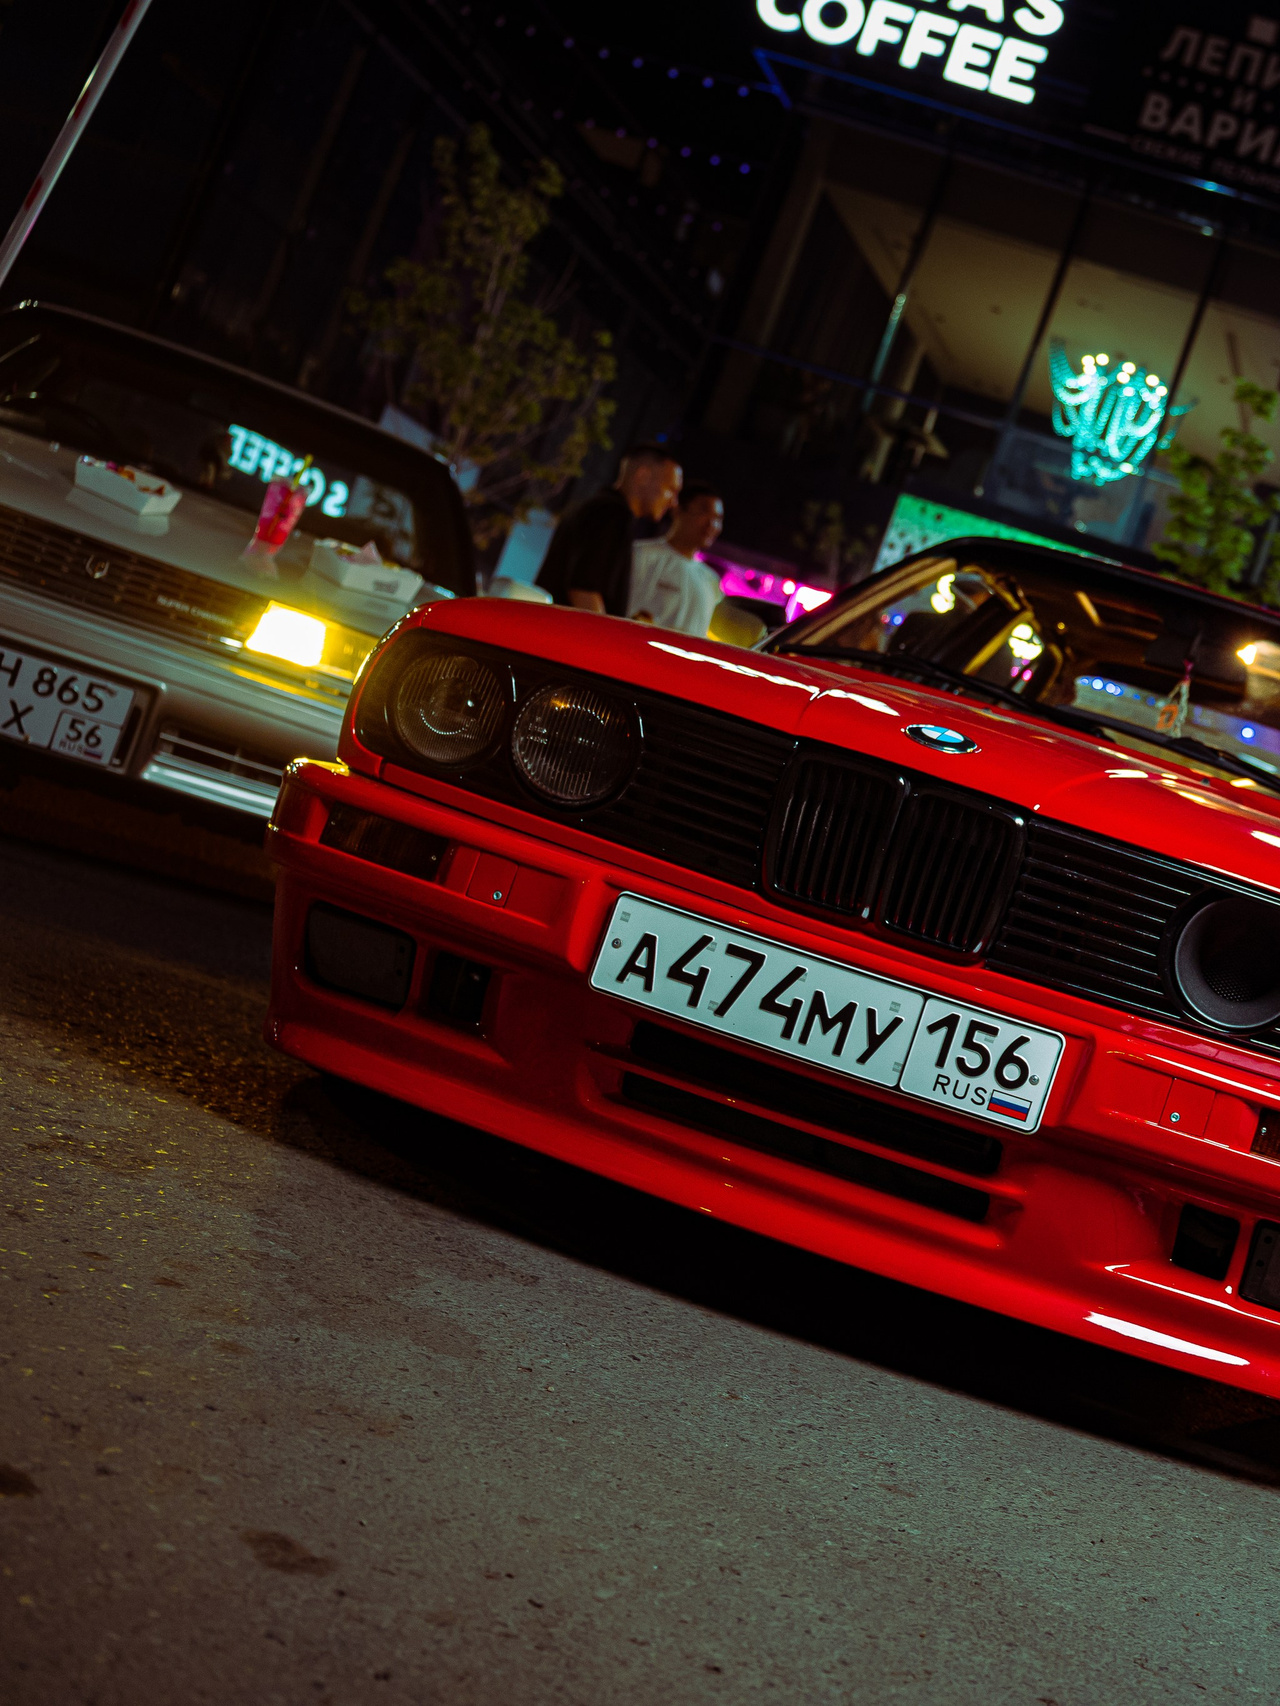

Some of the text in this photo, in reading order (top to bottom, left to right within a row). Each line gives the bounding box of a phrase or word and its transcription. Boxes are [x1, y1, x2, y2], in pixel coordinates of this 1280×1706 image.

[756, 0, 1048, 104] COFFEE
[33, 667, 115, 713] 865
[59, 740, 84, 756] RUS
[66, 718, 101, 748] 56
[926, 1012, 1031, 1090] 156
[932, 1073, 988, 1106] RUS
